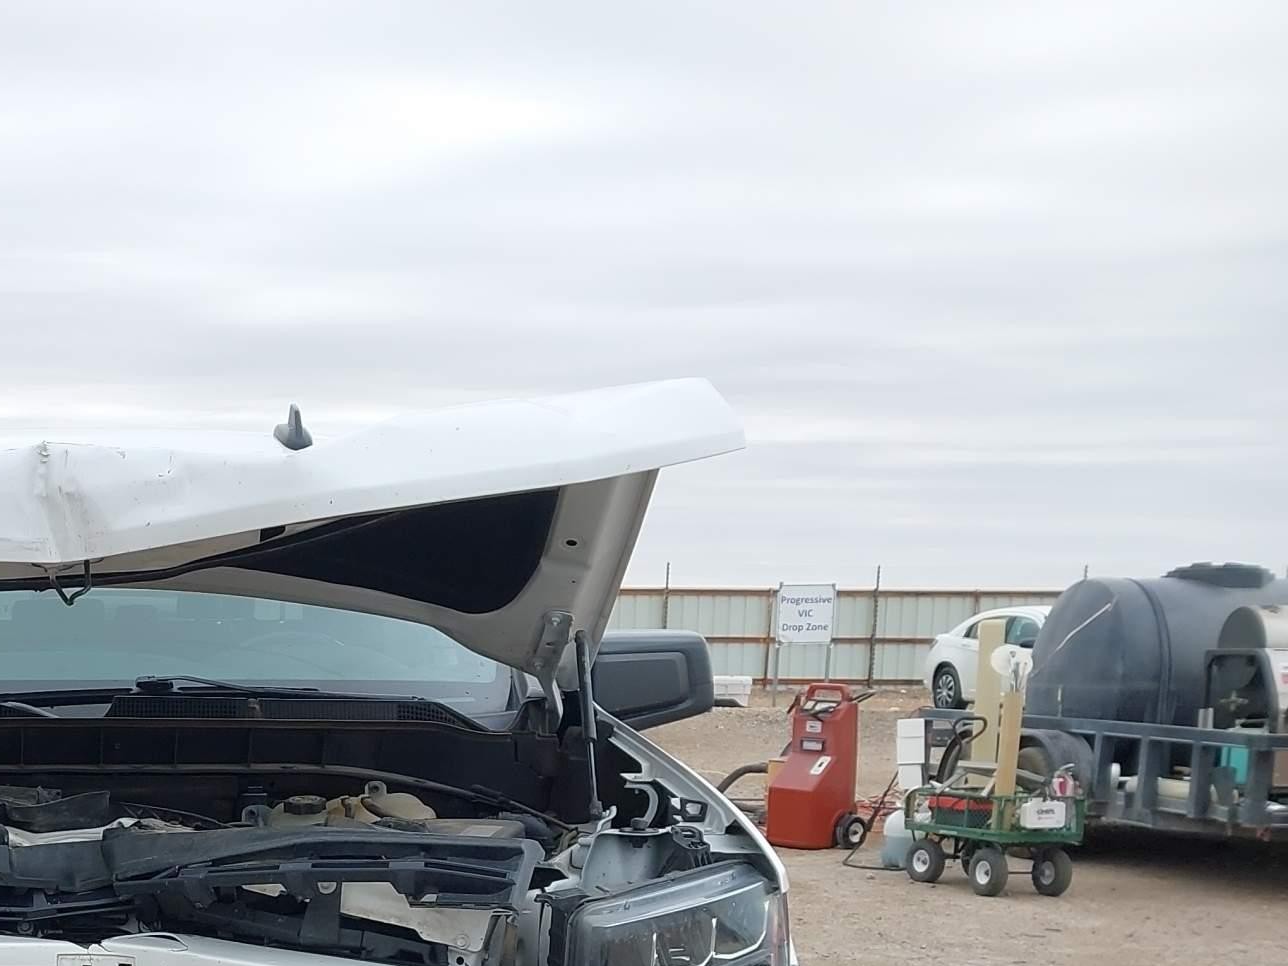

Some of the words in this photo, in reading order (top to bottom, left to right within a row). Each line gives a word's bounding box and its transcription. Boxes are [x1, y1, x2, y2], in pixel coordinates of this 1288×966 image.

[781, 595, 833, 606] Progressive
[798, 609, 814, 618] VIC
[782, 623, 804, 633] Drop
[805, 623, 829, 631] Zone
